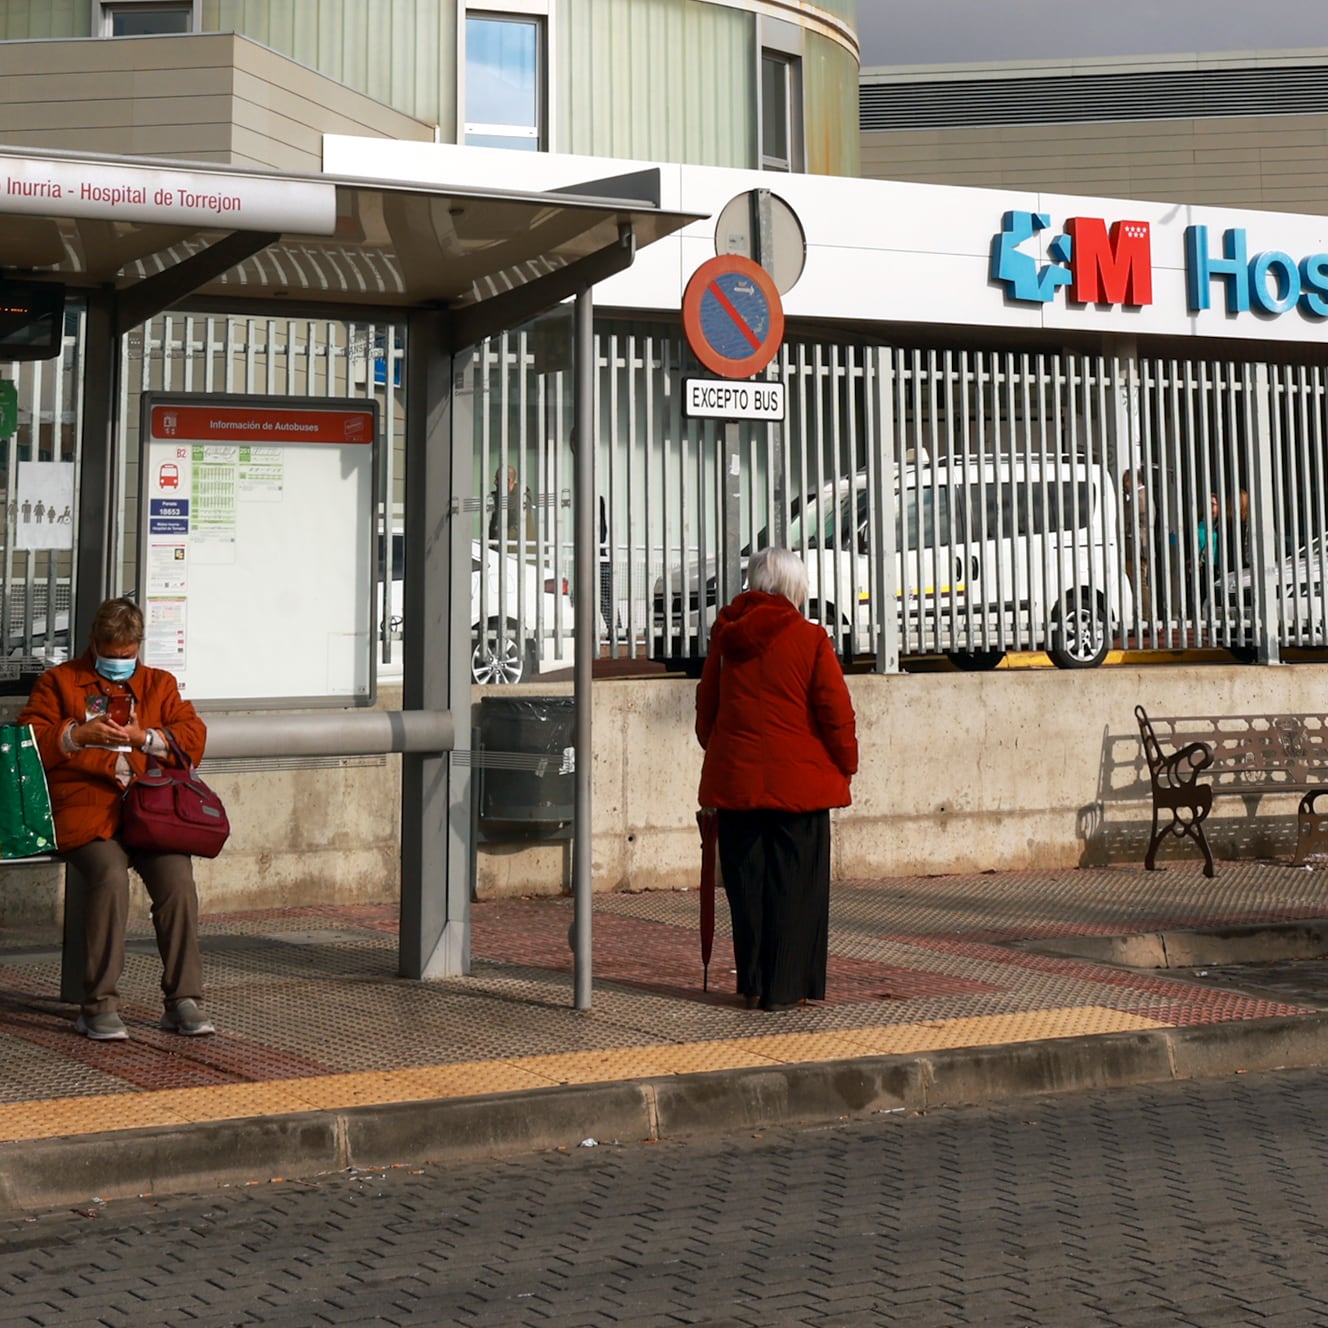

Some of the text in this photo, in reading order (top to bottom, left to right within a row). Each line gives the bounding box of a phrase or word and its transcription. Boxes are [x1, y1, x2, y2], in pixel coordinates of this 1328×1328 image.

[7, 176, 62, 199] Inurria
[80, 182, 146, 206] Hospital
[154, 188, 173, 206] de
[177, 189, 241, 214] Torrejon
[692, 386, 778, 412] EXCEPTO BUS
[210, 420, 319, 432] Información de Autobuses
[176, 448, 186, 458] B2
